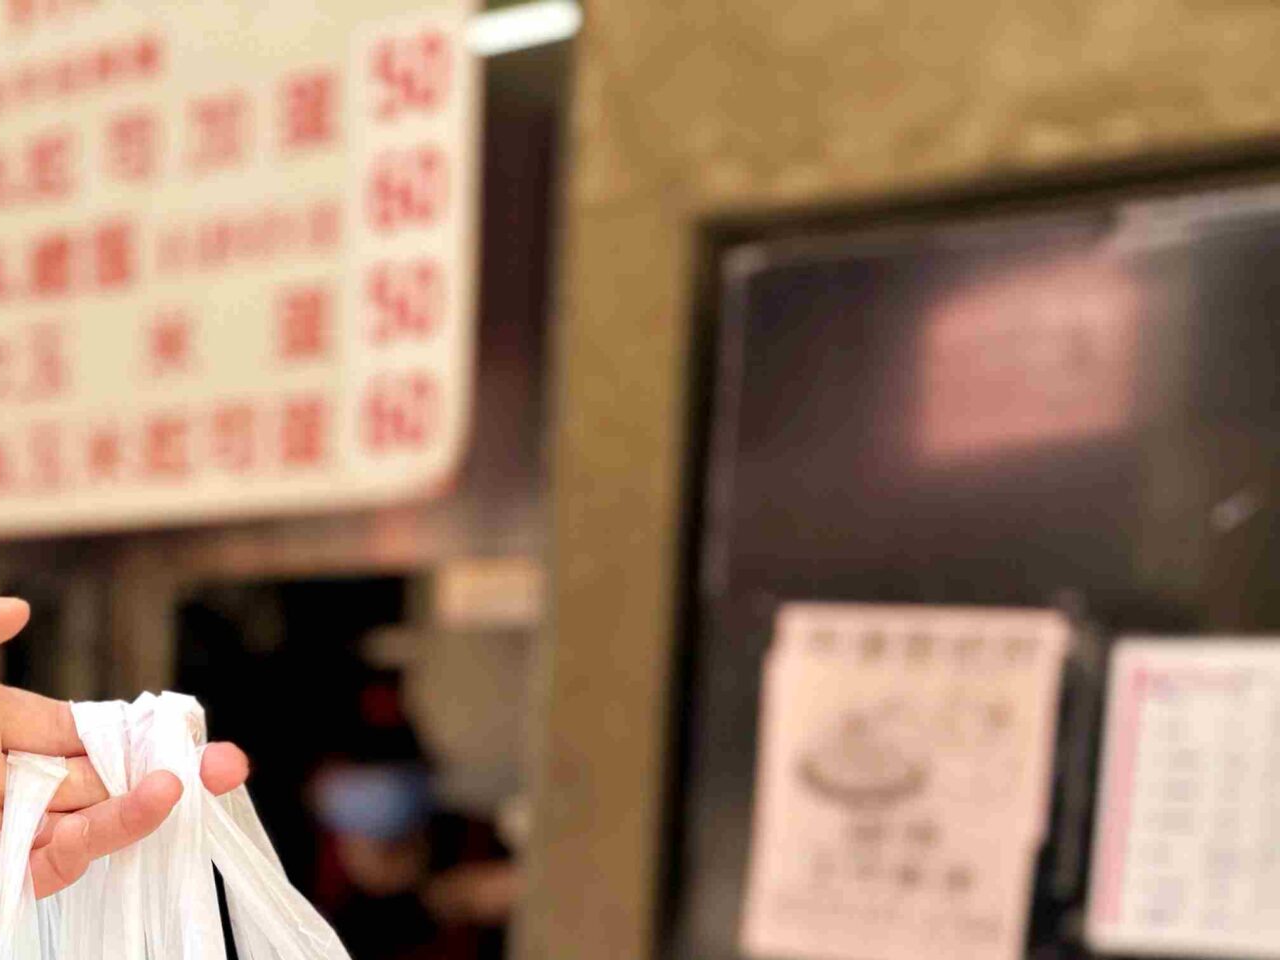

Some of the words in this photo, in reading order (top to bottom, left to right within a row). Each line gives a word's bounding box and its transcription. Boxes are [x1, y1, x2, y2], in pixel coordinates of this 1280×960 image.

[369, 32, 453, 122] 50
[363, 144, 450, 234] 60
[363, 256, 446, 345] 50
[358, 367, 442, 455] 60
